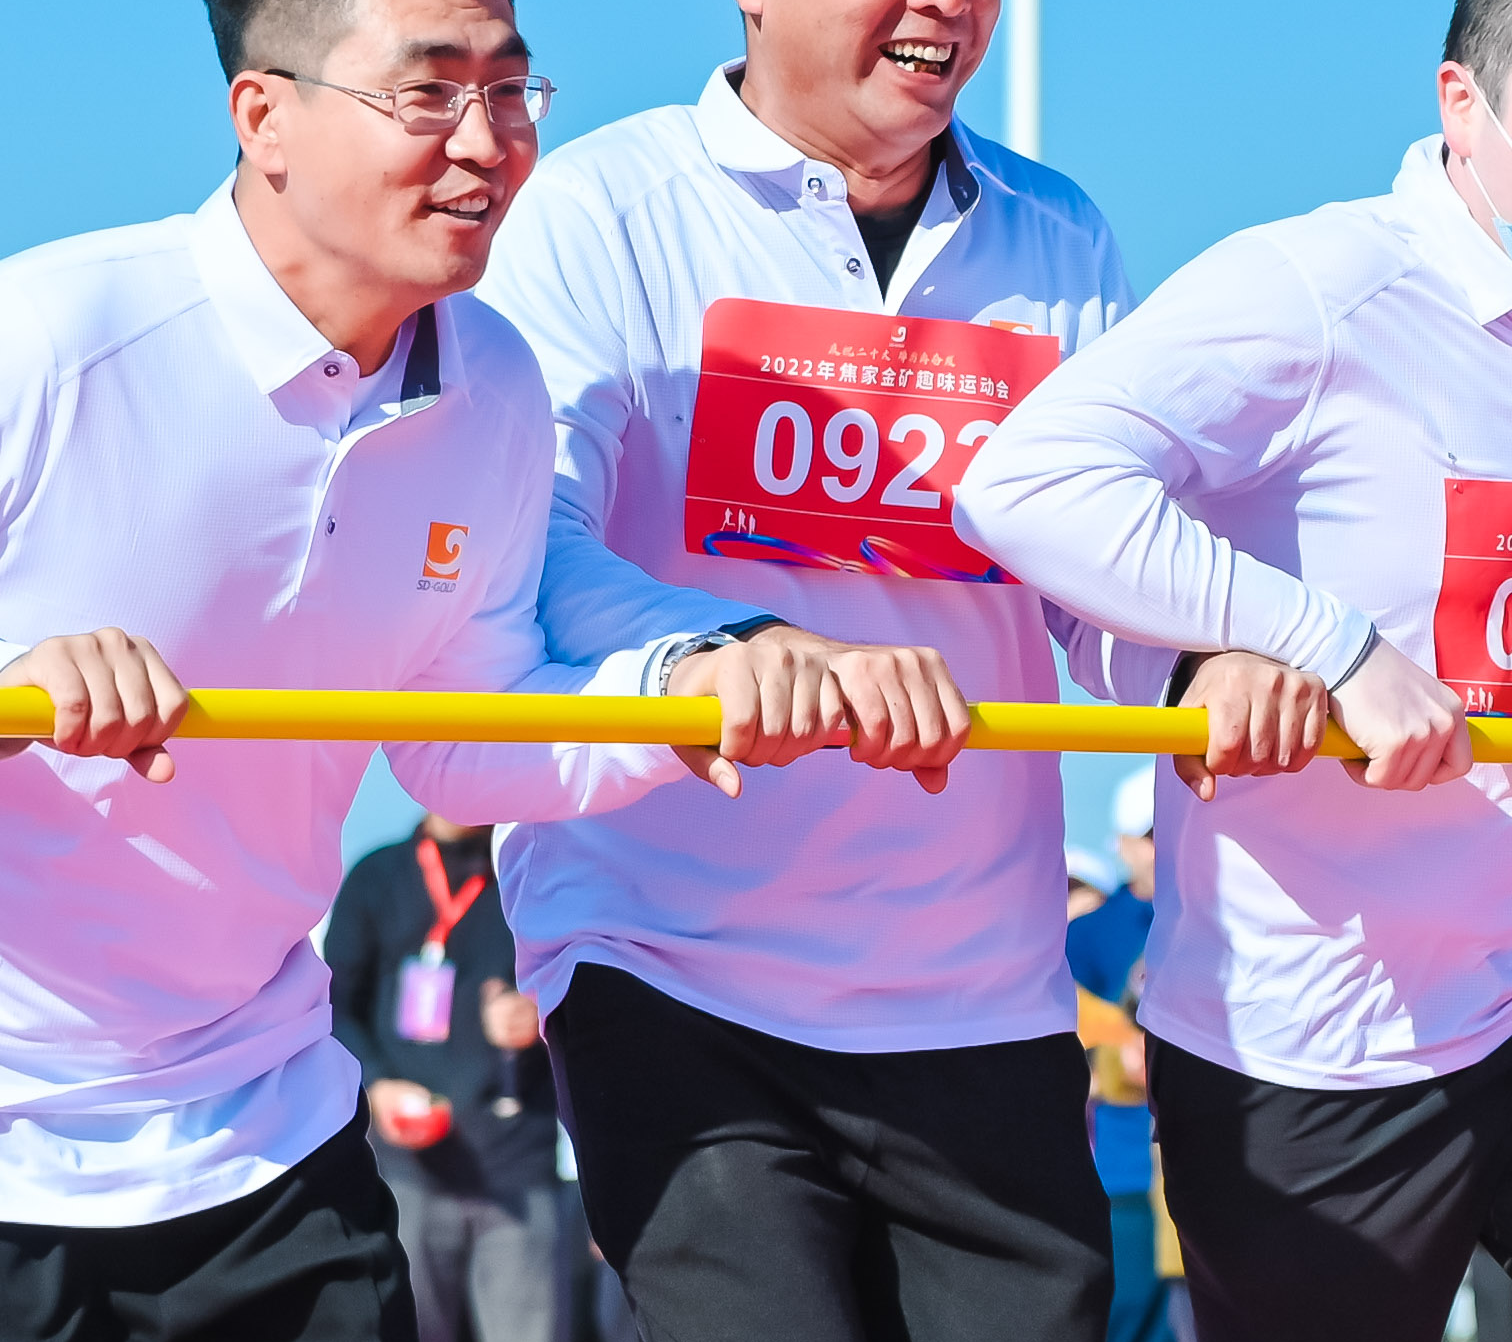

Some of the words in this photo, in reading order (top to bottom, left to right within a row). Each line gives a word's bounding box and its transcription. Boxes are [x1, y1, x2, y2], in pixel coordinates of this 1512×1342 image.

[759, 354, 1010, 401] 2022年焦家金矿趣味运动会
